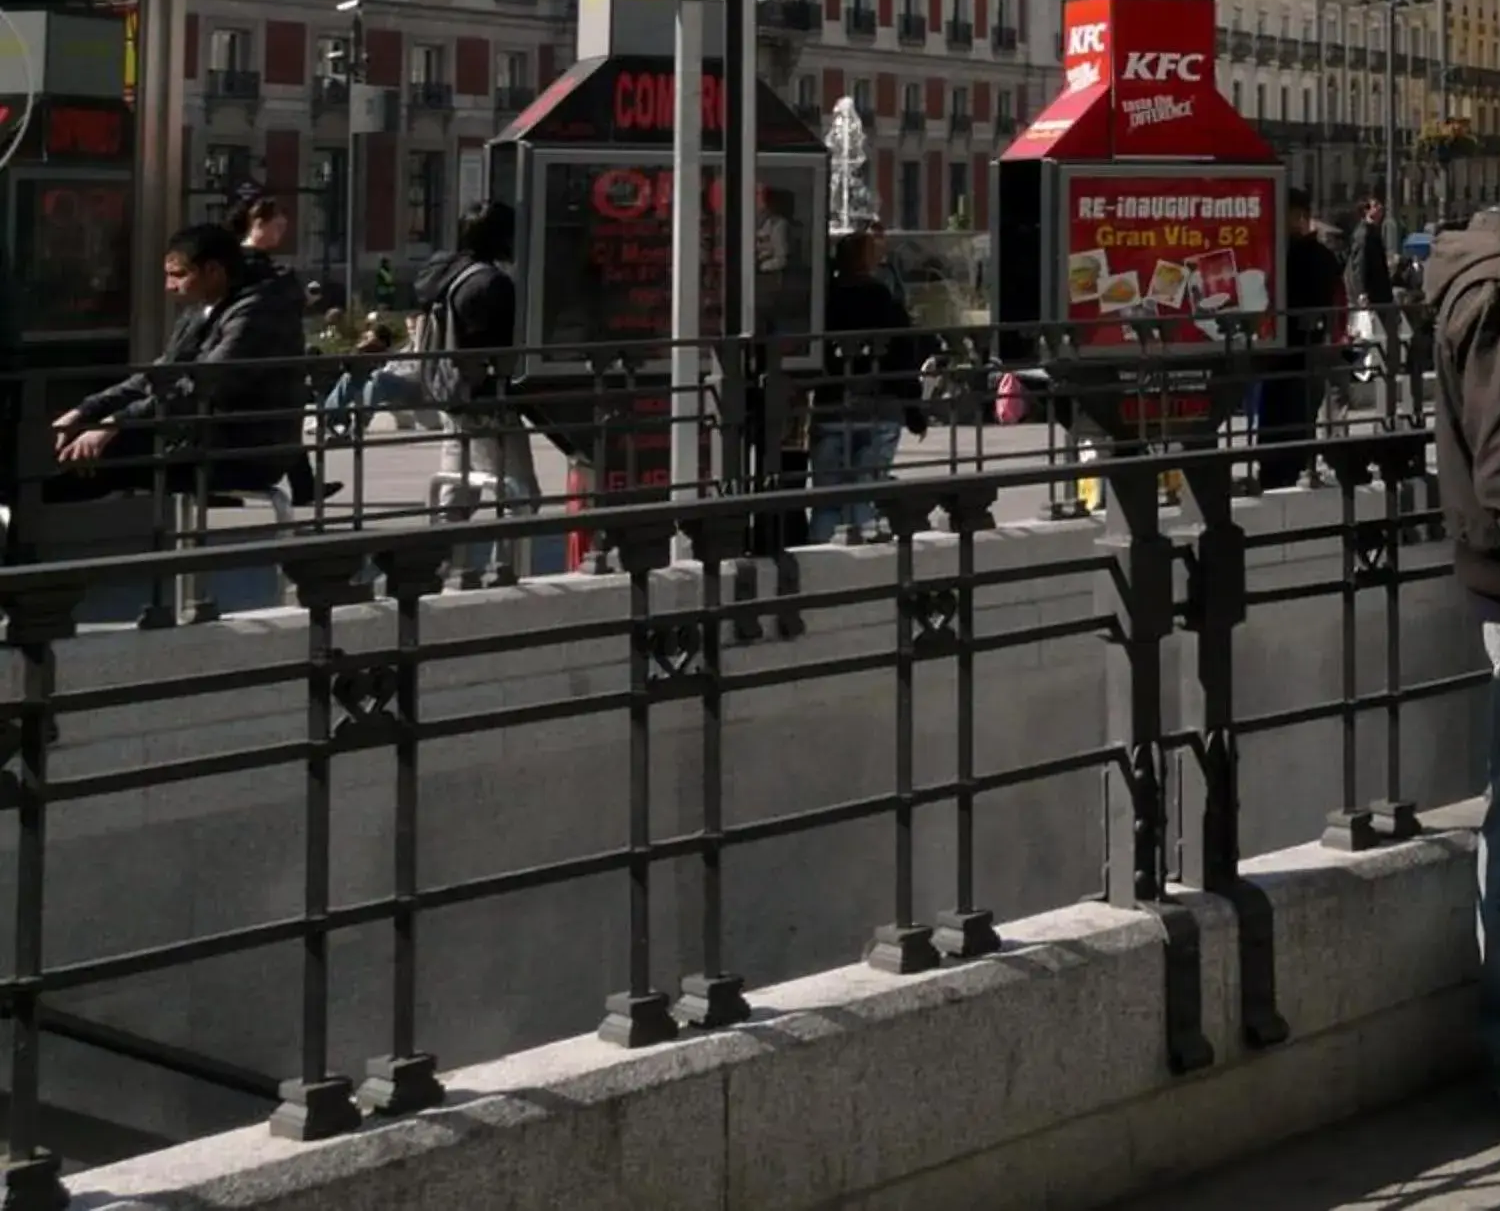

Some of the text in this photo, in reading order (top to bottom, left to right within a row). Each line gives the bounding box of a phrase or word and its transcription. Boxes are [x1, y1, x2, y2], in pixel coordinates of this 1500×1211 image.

[1069, 23, 1107, 55] KFC
[1121, 51, 1206, 81] KFC
[1096, 224, 1156, 247] Gran
[1218, 226, 1249, 246] 52
